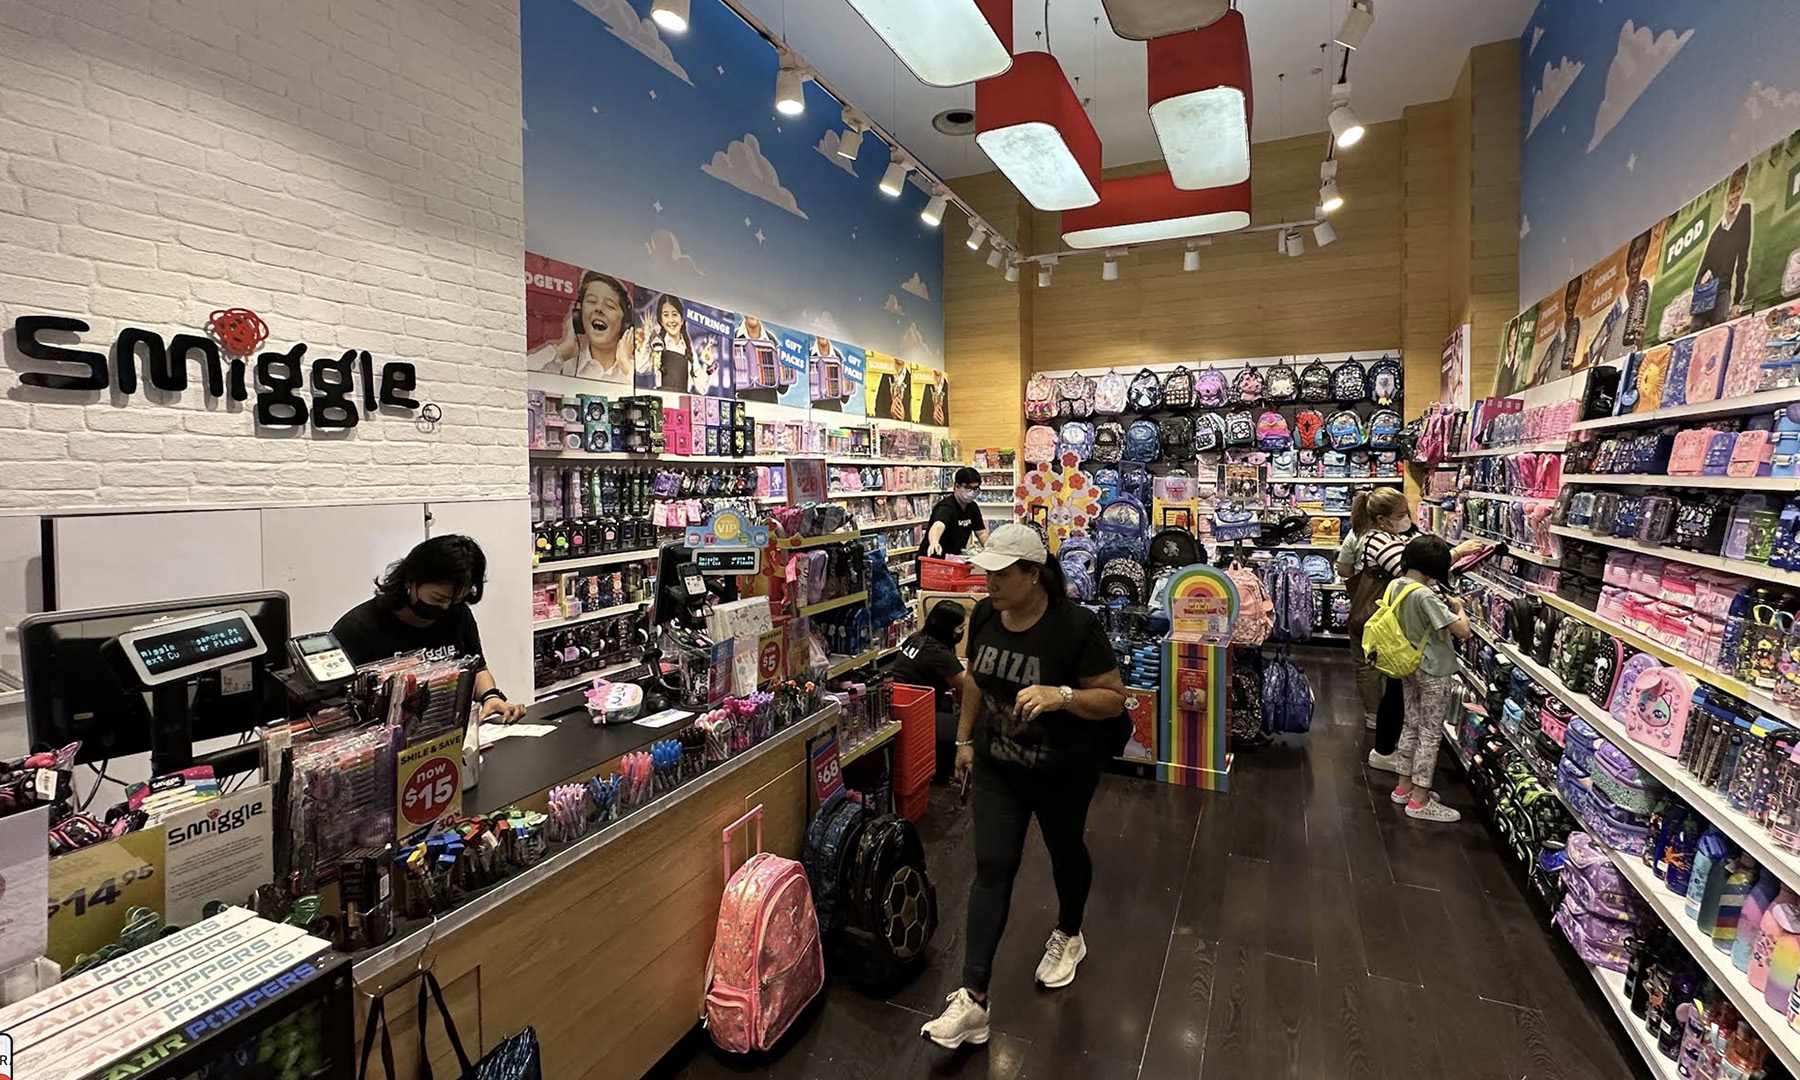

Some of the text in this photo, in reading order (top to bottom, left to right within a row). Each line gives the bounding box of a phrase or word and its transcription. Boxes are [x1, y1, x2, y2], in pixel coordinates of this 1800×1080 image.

[1667, 219, 1704, 264] FOOD
[686, 308, 731, 335] KEYRINGS
[784, 338, 803, 354] GIFT
[780, 351, 805, 369] PACKS
[844, 365, 863, 381] PACKS
[847, 353, 862, 367] GIFT
[717, 524, 737, 533] VIP
[213, 635, 244, 649] Please
[763, 655, 776, 672] $5
[973, 644, 1041, 685] IBIZA
[401, 735, 460, 766] SMILE & SAVE
[417, 762, 447, 784] now
[817, 759, 839, 784] $68
[405, 775, 454, 810] $15
[92, 919, 221, 981] POPPERS
[112, 929, 244, 996] POPPERS
[141, 938, 272, 1008] POPPERS
[163, 949, 296, 1023] POPPERS
[102, 962, 318, 1080] AIR POPPERS
